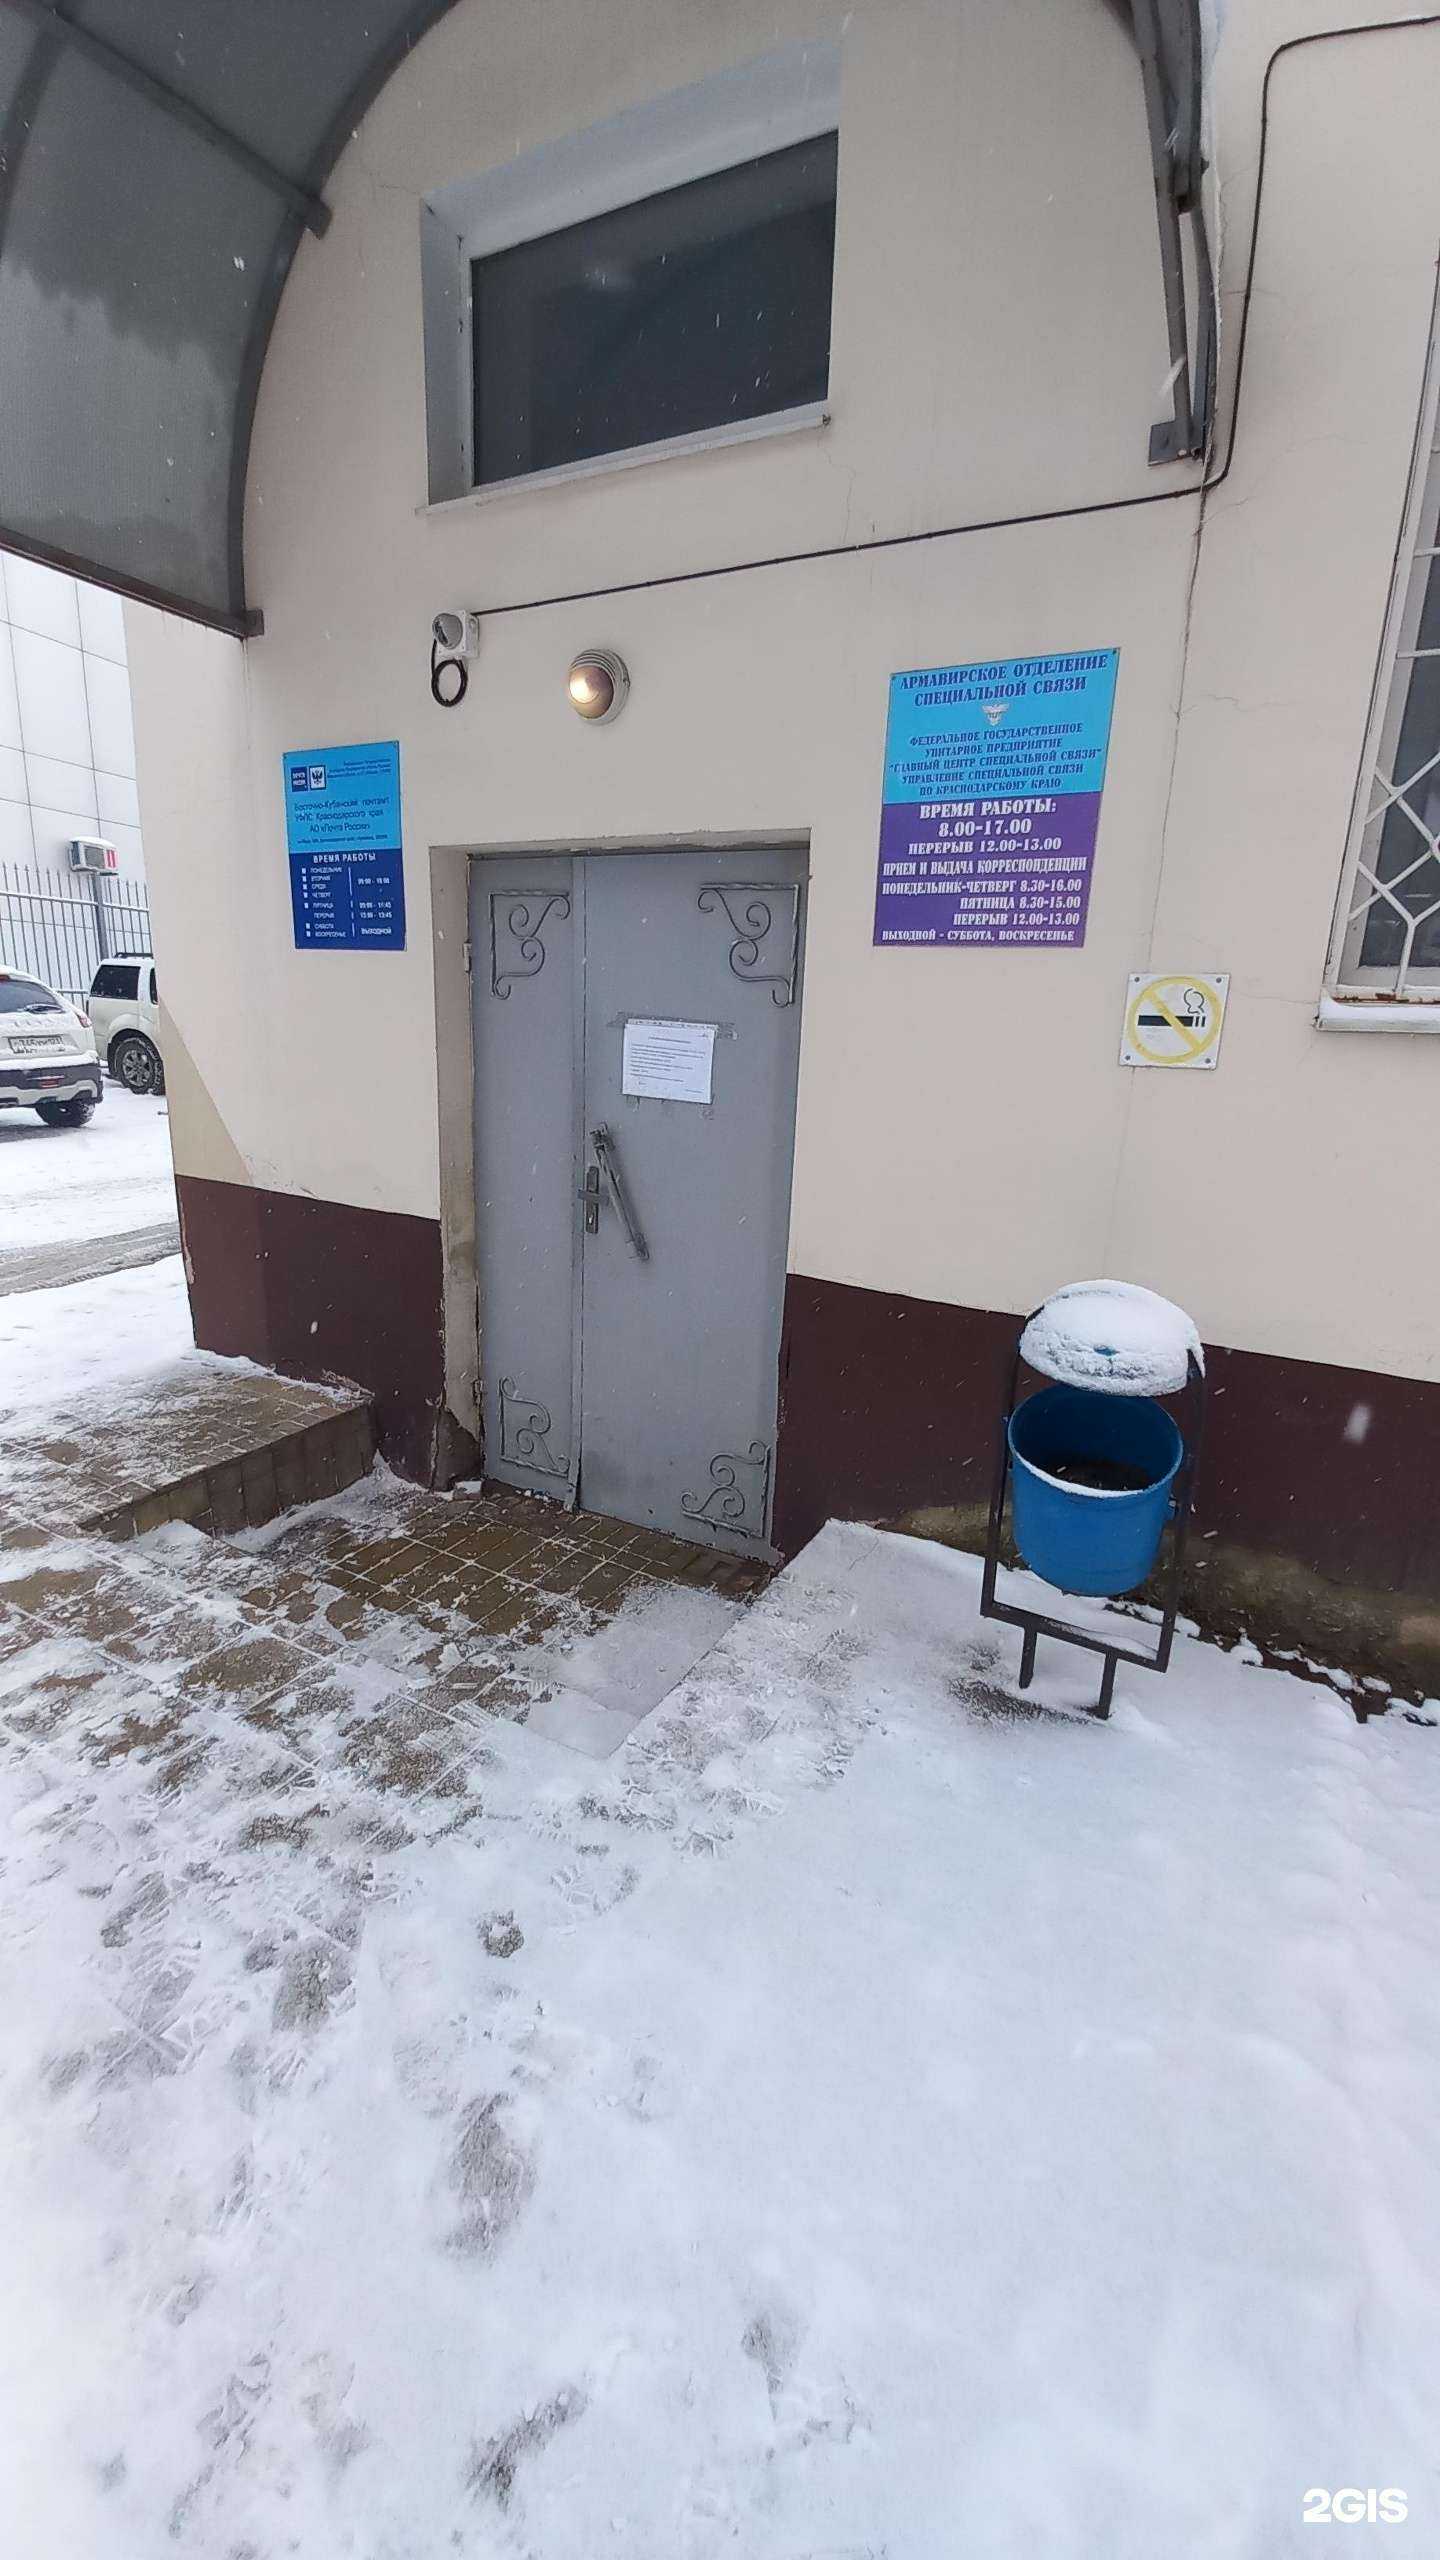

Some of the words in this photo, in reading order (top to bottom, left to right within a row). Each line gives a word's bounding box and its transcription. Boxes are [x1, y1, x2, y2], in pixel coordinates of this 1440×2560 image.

[900, 666, 1007, 690] АРМАВИРСКОЕ
[1013, 654, 1108, 678] ОТДЕЛЕНИЕ
[914, 680, 1027, 707] СПЕЦИАЛЬНОЙ
[1033, 677, 1087, 695] СВЯЗИ
[910, 731, 980, 746] ФЕДЕРАЛЬНОЕ
[984, 722, 1083, 740] ГОСУДАРСТВЕННОЕ
[925, 742, 983, 758] УНИТАРНОЕ
[987, 738, 1063, 754] ПРЕДПРИЯТИЕ
[890, 759, 940, 773] "ГЛАВНЫЙ
[944, 757, 976, 771] ЦЕНТР
[979, 749, 1056, 767] СПЕЦИАЛЬНОЙ
[1061, 748, 1102, 761] СВЯЗИ"
[902, 770, 964, 785] УПРАВЛЕНИЕ
[968, 763, 1047, 780] СПЕЦИАЛЬНОЙ
[1049, 763, 1083, 775] СВЯЗИ
[920, 786, 933, 796] ПО
[936, 780, 1027, 795] КРАСНОДАРСКОМУ
[1031, 778, 1061, 789] КРАЮ
[920, 802, 975, 819] ВРЕМЯ
[980, 798, 1057, 816] РАБОТЫ:
[938, 818, 1032, 837] 8.00-17.00
[908, 841, 973, 855] ПЕРЕРЫВ
[980, 837, 1062, 852] 12.00-13.00
[313, 855, 340, 863] ВРЕМЯ
[343, 852, 376, 862] РАБОТЫ
[883, 862, 916, 876] ПРИЕМ
[919, 862, 928, 875] И
[930, 860, 973, 877] ВЫДАЧА
[977, 857, 1087, 874] КОРРЕСПОНДЕНЦИИ
[882, 880, 1017, 896] ПОНЕДЕЛЬНИК-ЧЕТВЕРГ
[1019, 879, 1082, 893] 8.30-16.00
[960, 897, 1015, 911] ПЯТНИЦА
[1019, 896, 1081, 909] 8.30-15.00
[953, 913, 1008, 926] ПЕРЕРЫВ
[1012, 913, 1080, 926] 12.00-13.00
[361, 926, 392, 935] ВЫХОДНОЙ
[882, 929, 936, 942] ВЫХОДНОЙ
[947, 930, 995, 942] СУББОТА,
[998, 930, 1075, 941] ВОСКРЕСЕНЬЕ
